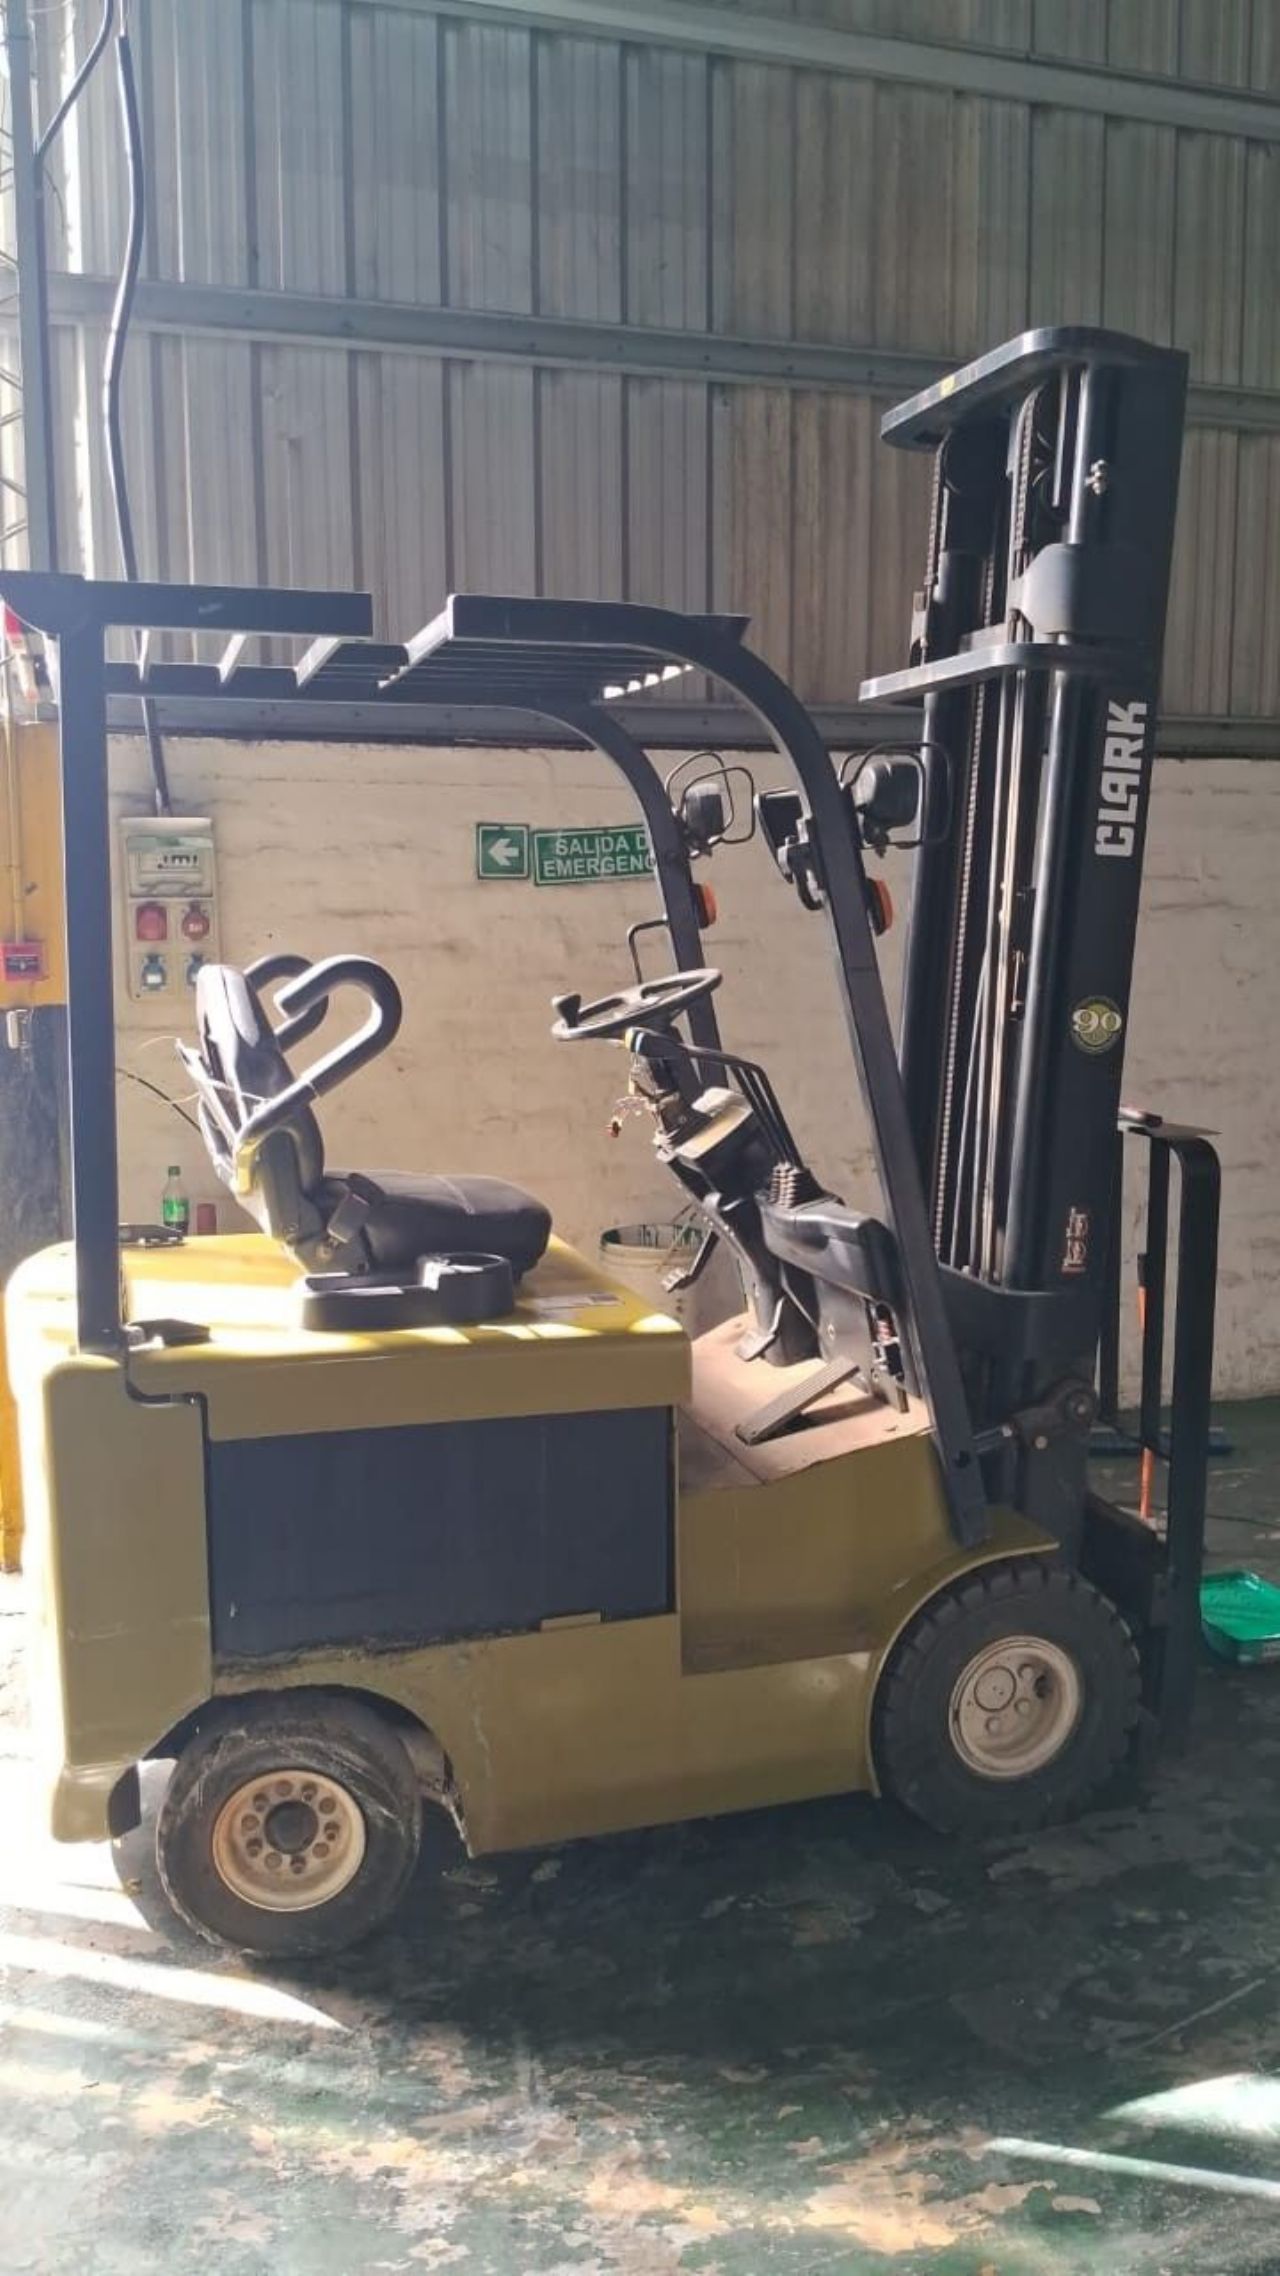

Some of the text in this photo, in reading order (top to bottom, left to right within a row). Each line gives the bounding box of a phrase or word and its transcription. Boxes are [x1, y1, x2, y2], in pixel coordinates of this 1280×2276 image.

[1094, 700, 1147, 857] CLARK
[555, 833, 649, 857] SALIDA D
[543, 854, 656, 877] EMERGENC
[1072, 1009, 1122, 1033] 90
